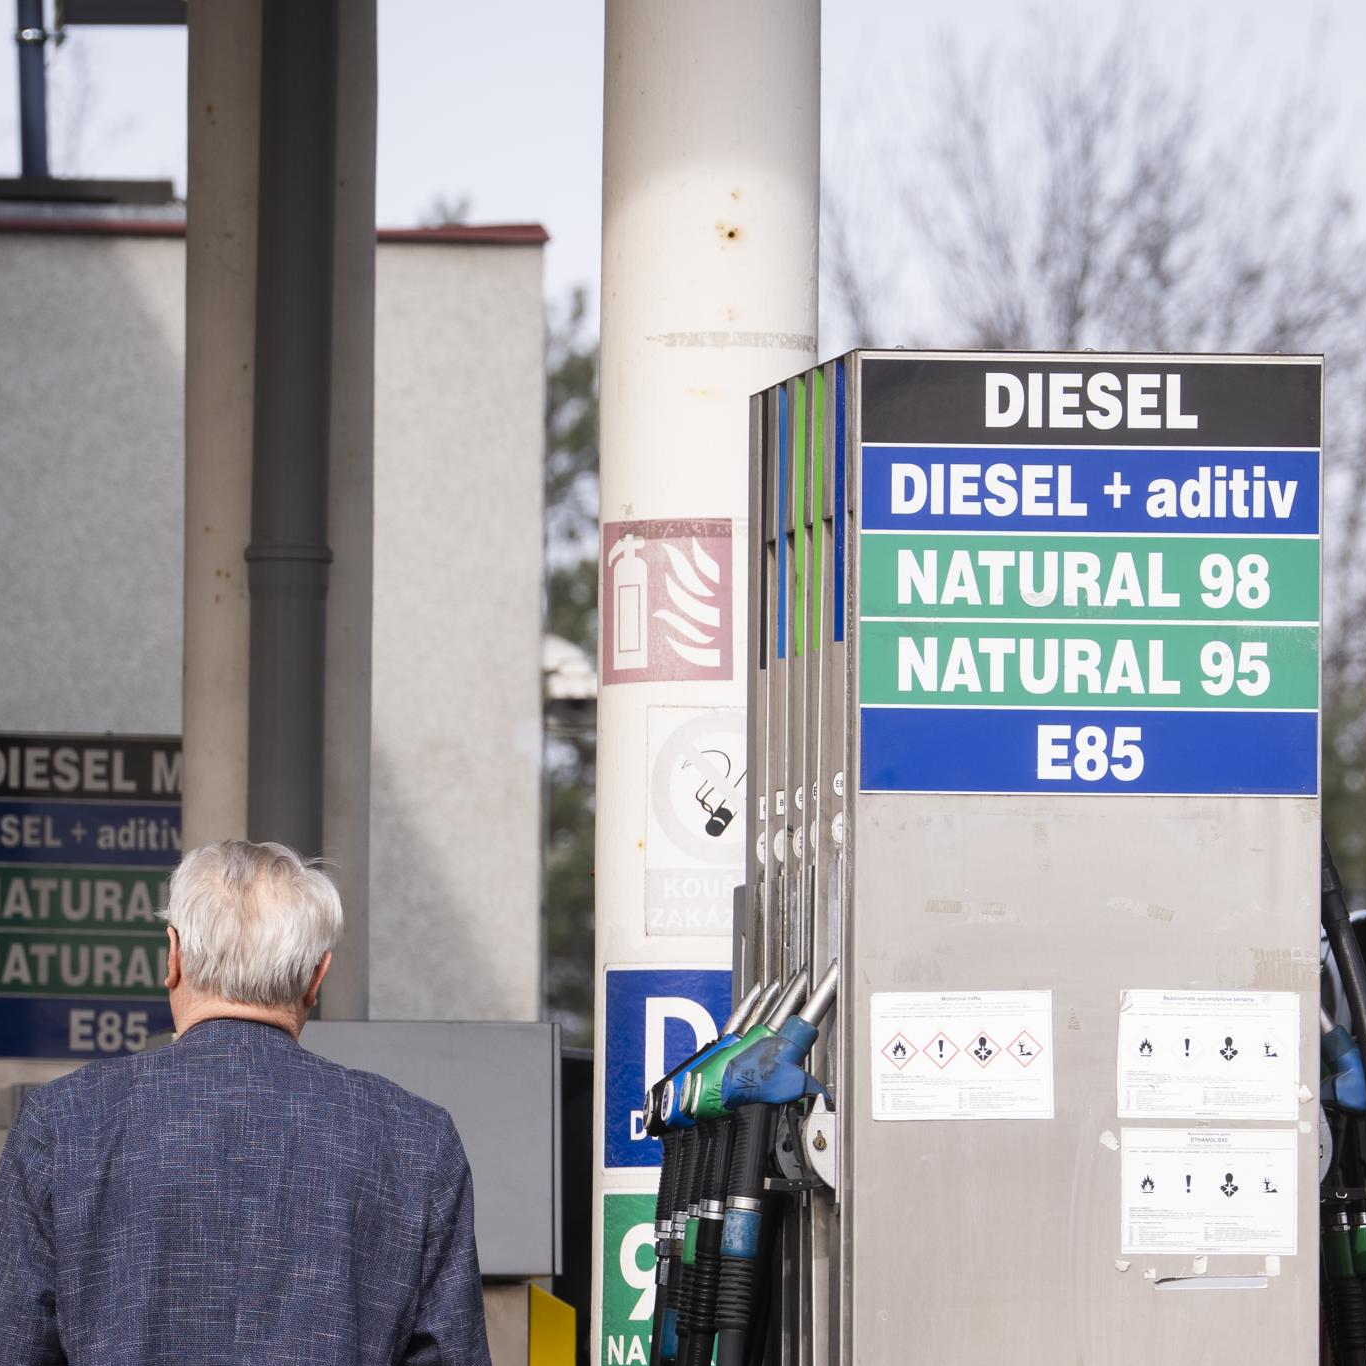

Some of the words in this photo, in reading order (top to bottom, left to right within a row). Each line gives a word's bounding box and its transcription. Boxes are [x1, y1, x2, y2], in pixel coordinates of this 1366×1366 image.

[984, 371, 1199, 430] DIESEL
[890, 463, 1088, 517] DIESEL
[1103, 471, 1131, 509] +
[1146, 465, 1298, 519] aditiv
[896, 549, 1180, 607] NATURAL
[1199, 553, 1272, 609] 98
[897, 636, 1181, 695] NATURAL
[1199, 641, 1272, 697] 95
[1037, 724, 1145, 782] E85
[69, 1009, 149, 1052] E85
